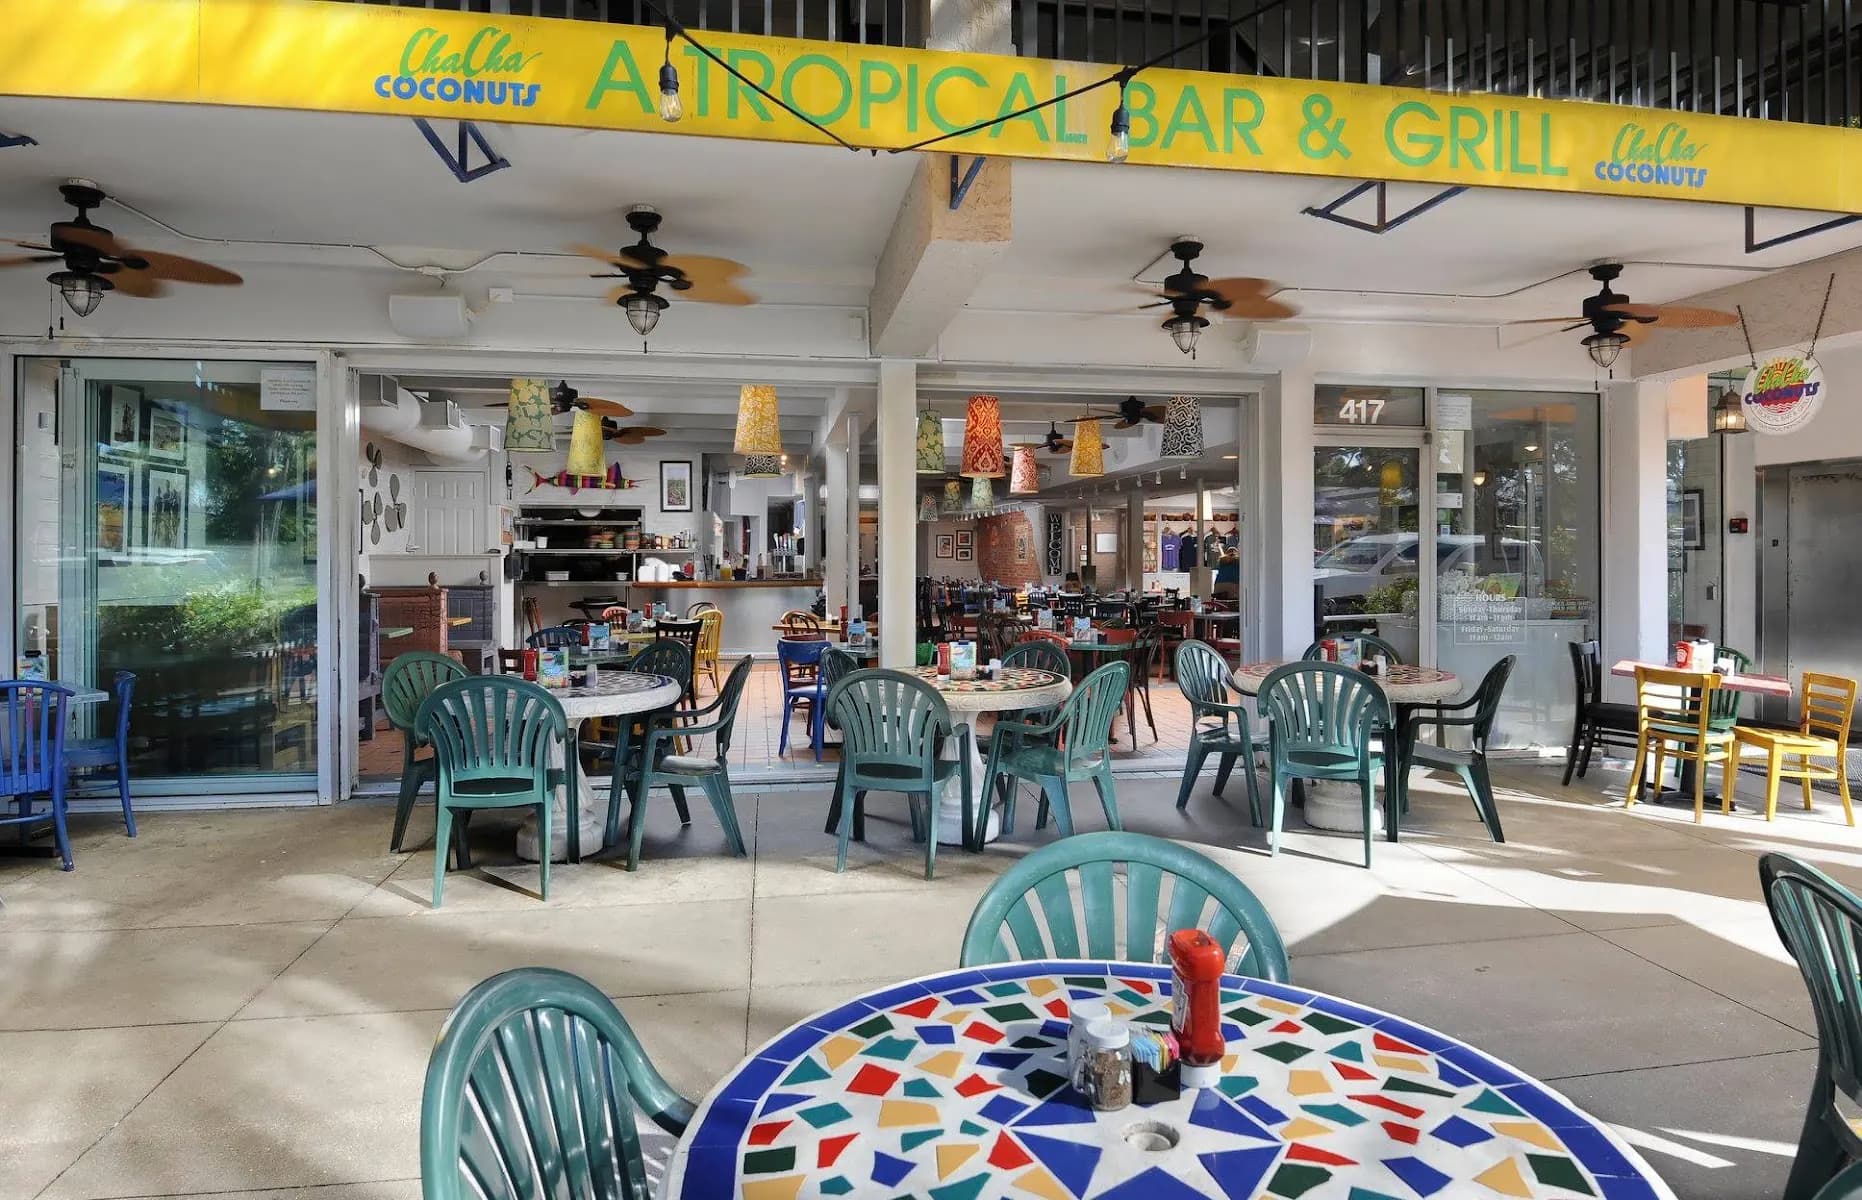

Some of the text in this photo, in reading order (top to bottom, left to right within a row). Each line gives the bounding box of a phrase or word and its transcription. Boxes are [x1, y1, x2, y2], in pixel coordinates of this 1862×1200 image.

[374, 75, 541, 107] COCONUTS
[587, 40, 1568, 176] A TROPICAL BAR & GRILL
[1595, 161, 1708, 188] COCONUTS
[1744, 381, 1821, 405] COCONUTS
[1339, 399, 1385, 424] 417
[1048, 511, 1062, 577] WELCOME
[1475, 592, 1507, 602] HOURS
